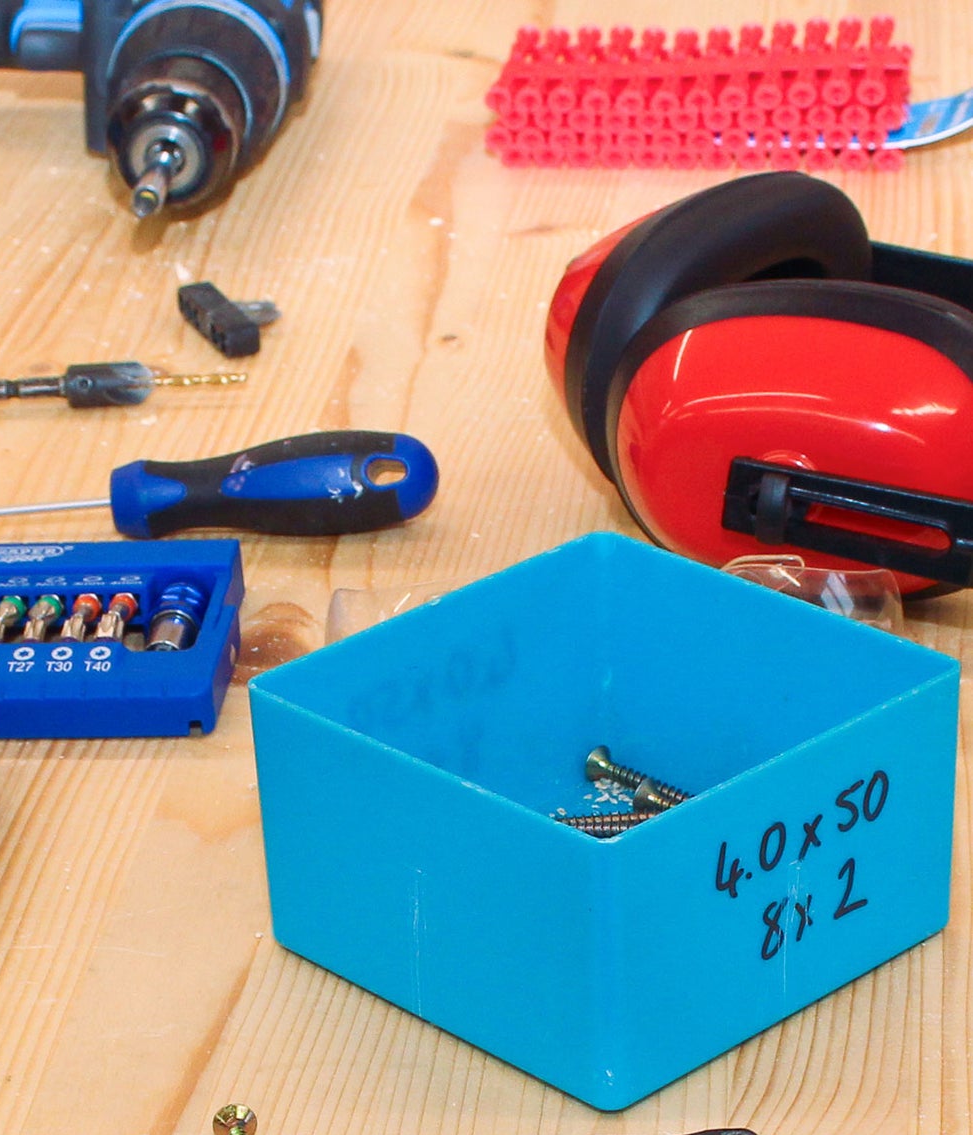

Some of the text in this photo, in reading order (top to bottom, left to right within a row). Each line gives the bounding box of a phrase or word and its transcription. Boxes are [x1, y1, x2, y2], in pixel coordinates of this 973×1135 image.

[8, 661, 35, 672] T27
[46, 661, 73, 672] T30
[84, 661, 112, 672] T40
[716, 821, 786, 898] 4.0
[835, 770, 889, 832] 50
[762, 897, 789, 960] 8
[833, 857, 869, 920] 2
